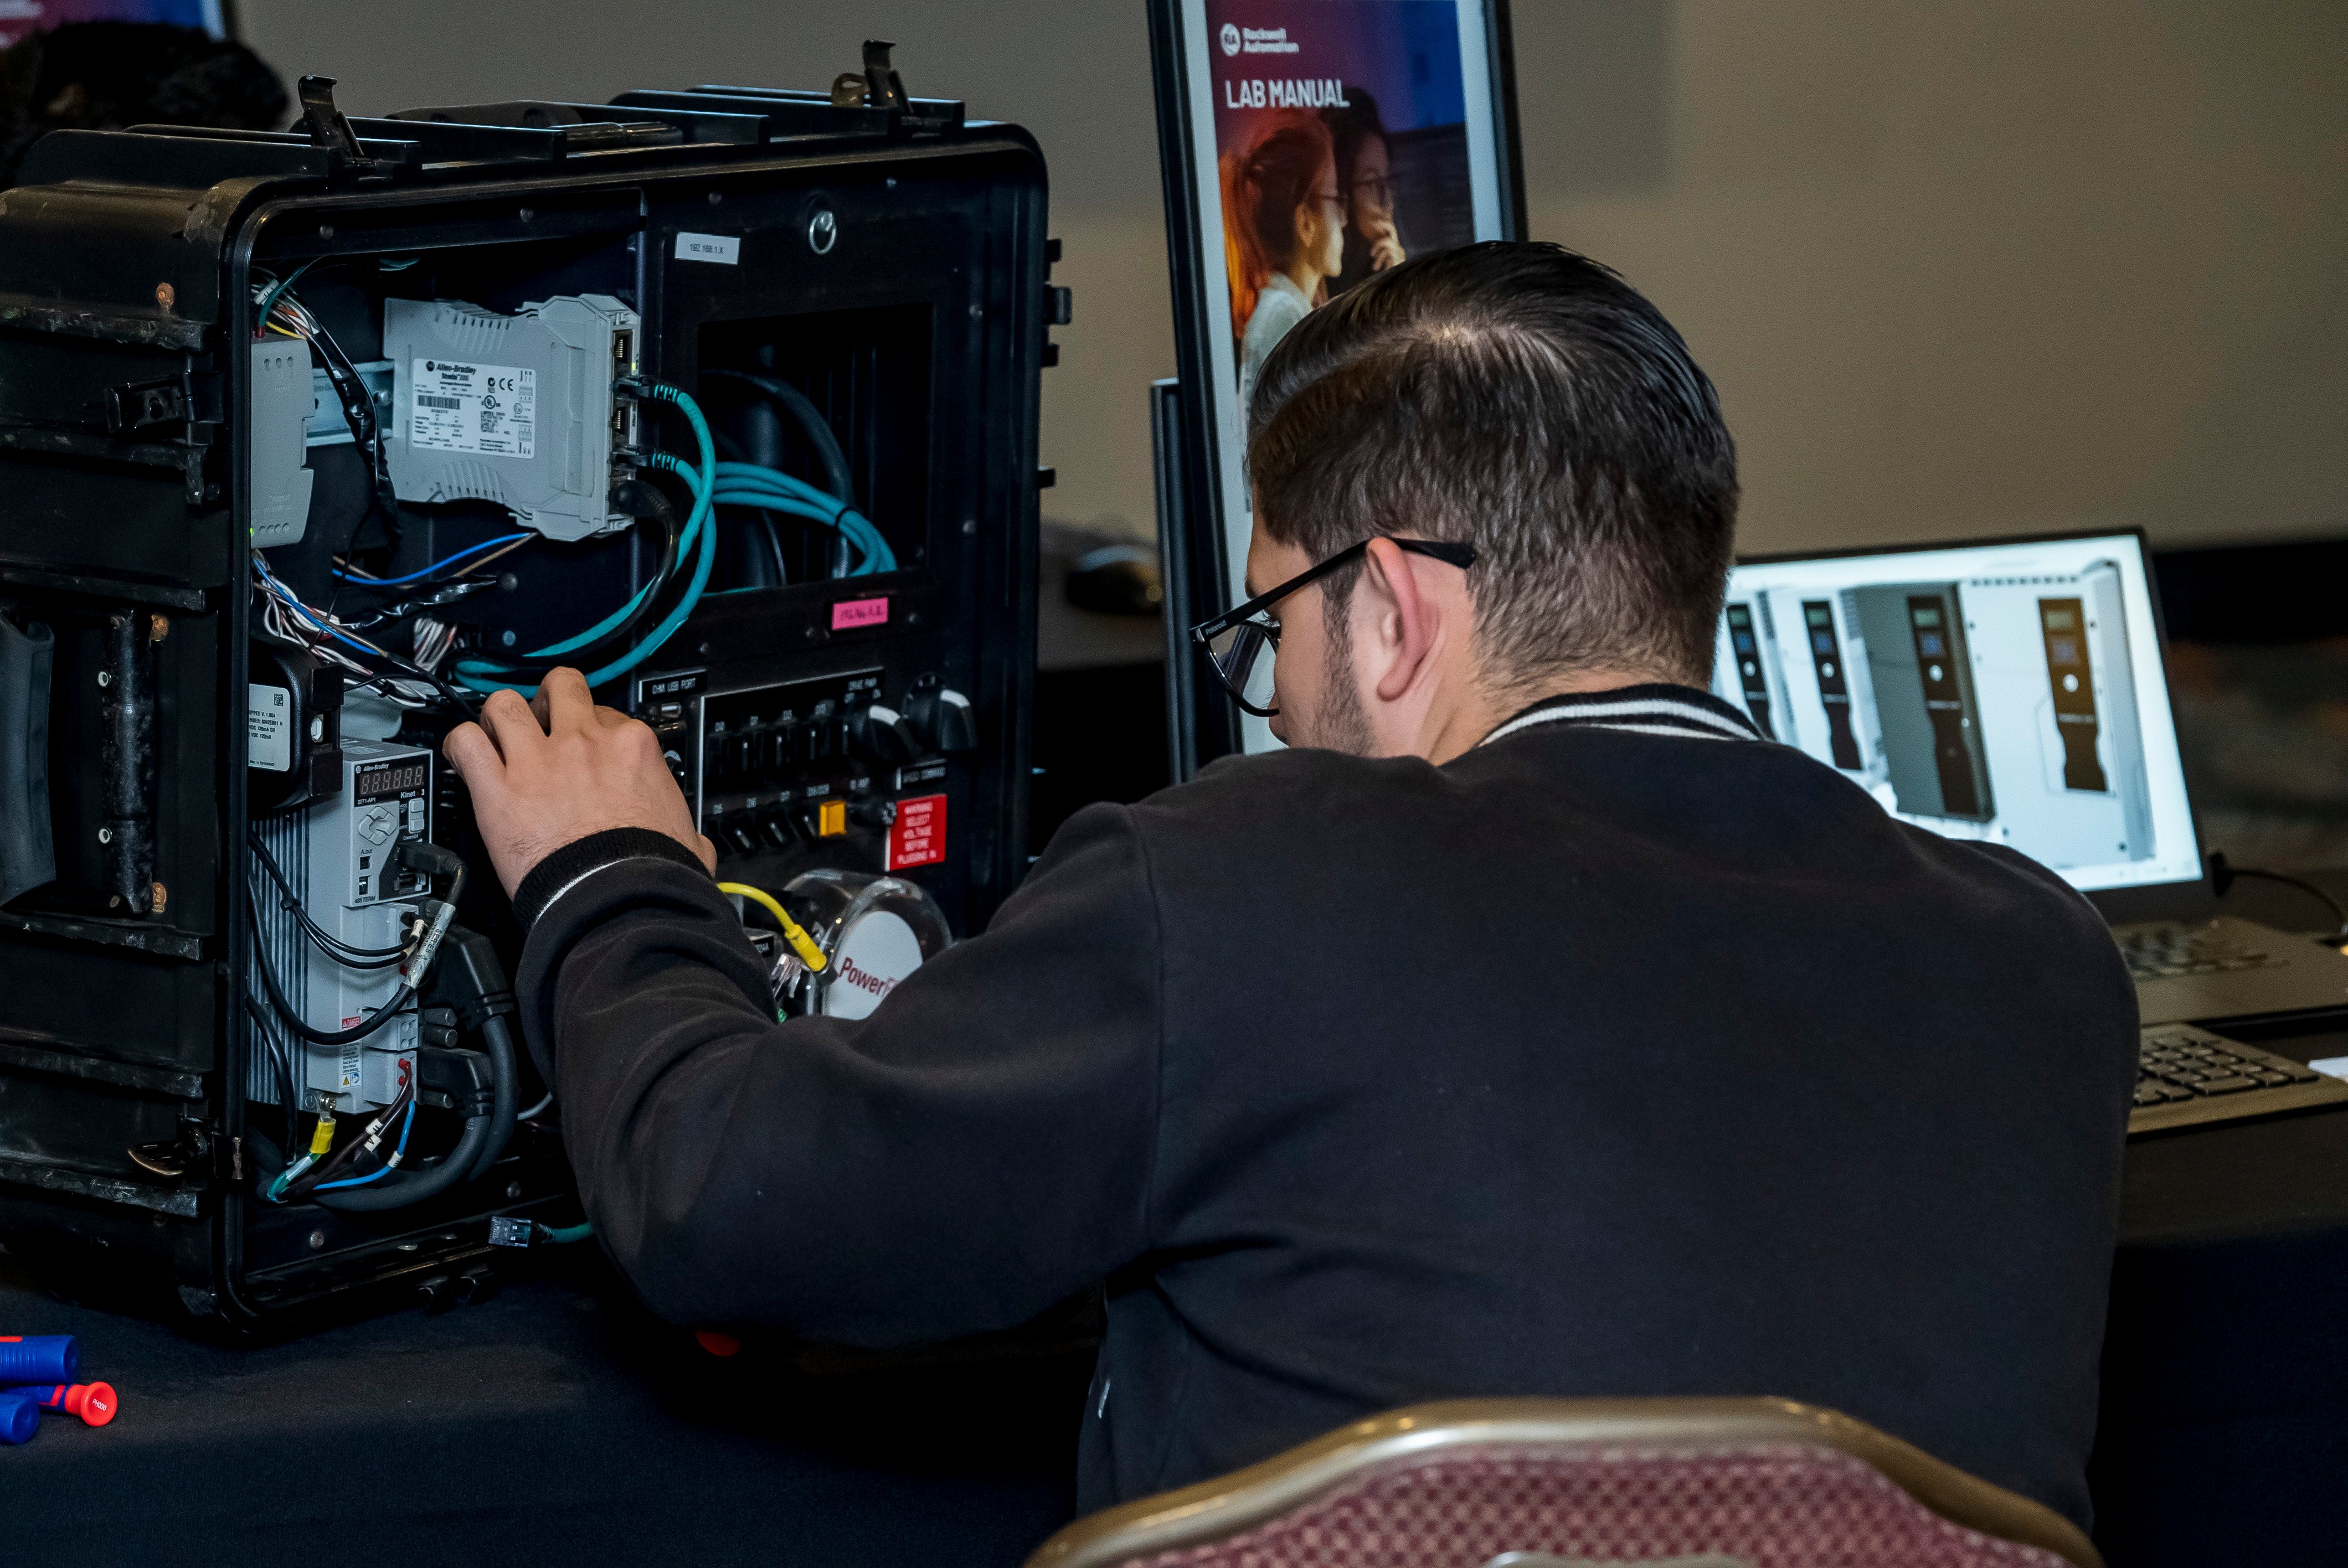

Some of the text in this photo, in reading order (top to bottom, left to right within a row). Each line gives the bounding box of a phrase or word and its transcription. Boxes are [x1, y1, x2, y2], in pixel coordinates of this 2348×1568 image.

[1243, 28, 1286, 40] Rockwell
[1244, 41, 1299, 53] Automation
[1225, 79, 1351, 109] LAB MANUAL
[436, 363, 476, 375] Allen-Bradley
[363, 764, 389, 772] Allen-Bradley
